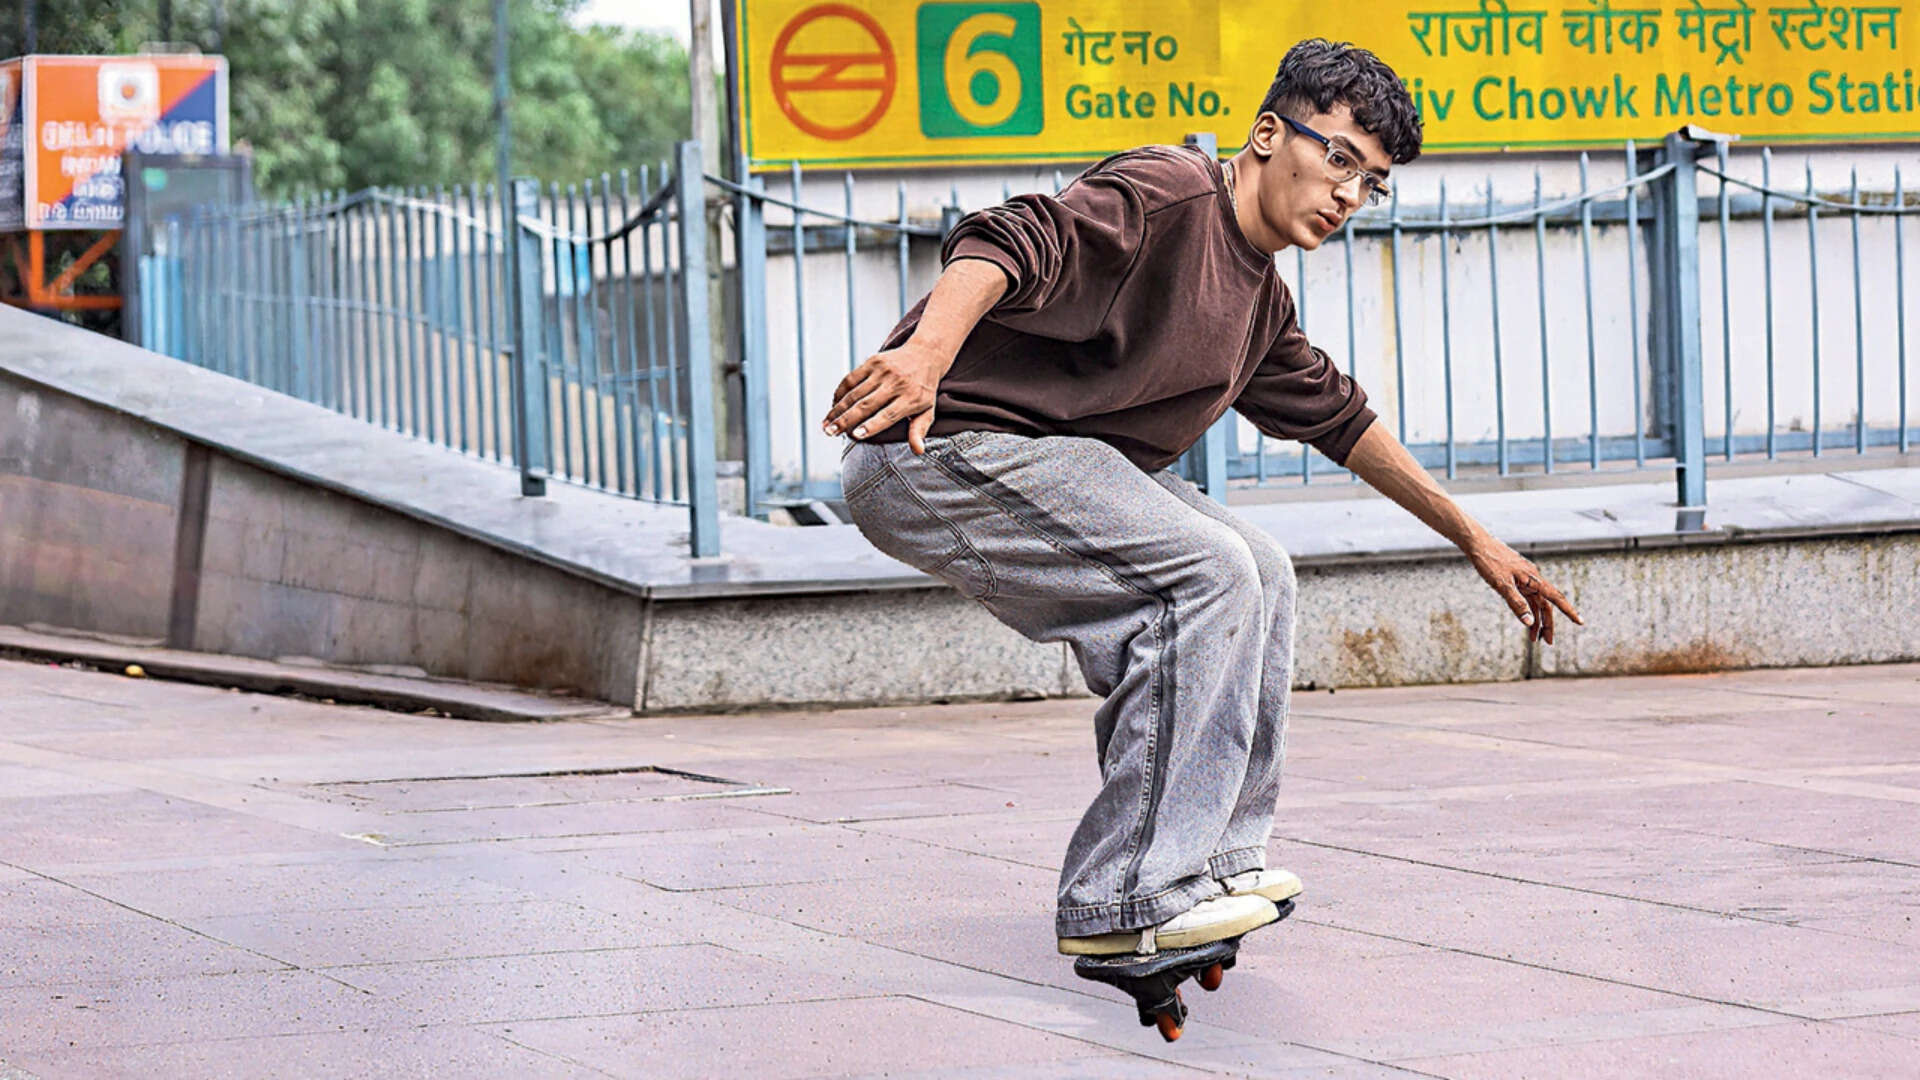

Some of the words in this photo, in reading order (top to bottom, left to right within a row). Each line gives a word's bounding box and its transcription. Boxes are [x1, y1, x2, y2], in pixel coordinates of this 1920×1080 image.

[1062, 16, 1116, 66] गेट
[1407, 0, 1548, 56] राजीव
[1675, 0, 1756, 65] मेट्रो
[1768, 0, 1902, 51] स्टेशन
[944, 12, 1022, 125] 6
[1473, 73, 1640, 120] Chowk
[1654, 72, 1793, 117] Metro
[1808, 68, 1920, 115] Stati
[1065, 83, 1156, 119] Gate
[1168, 81, 1231, 117] No.
